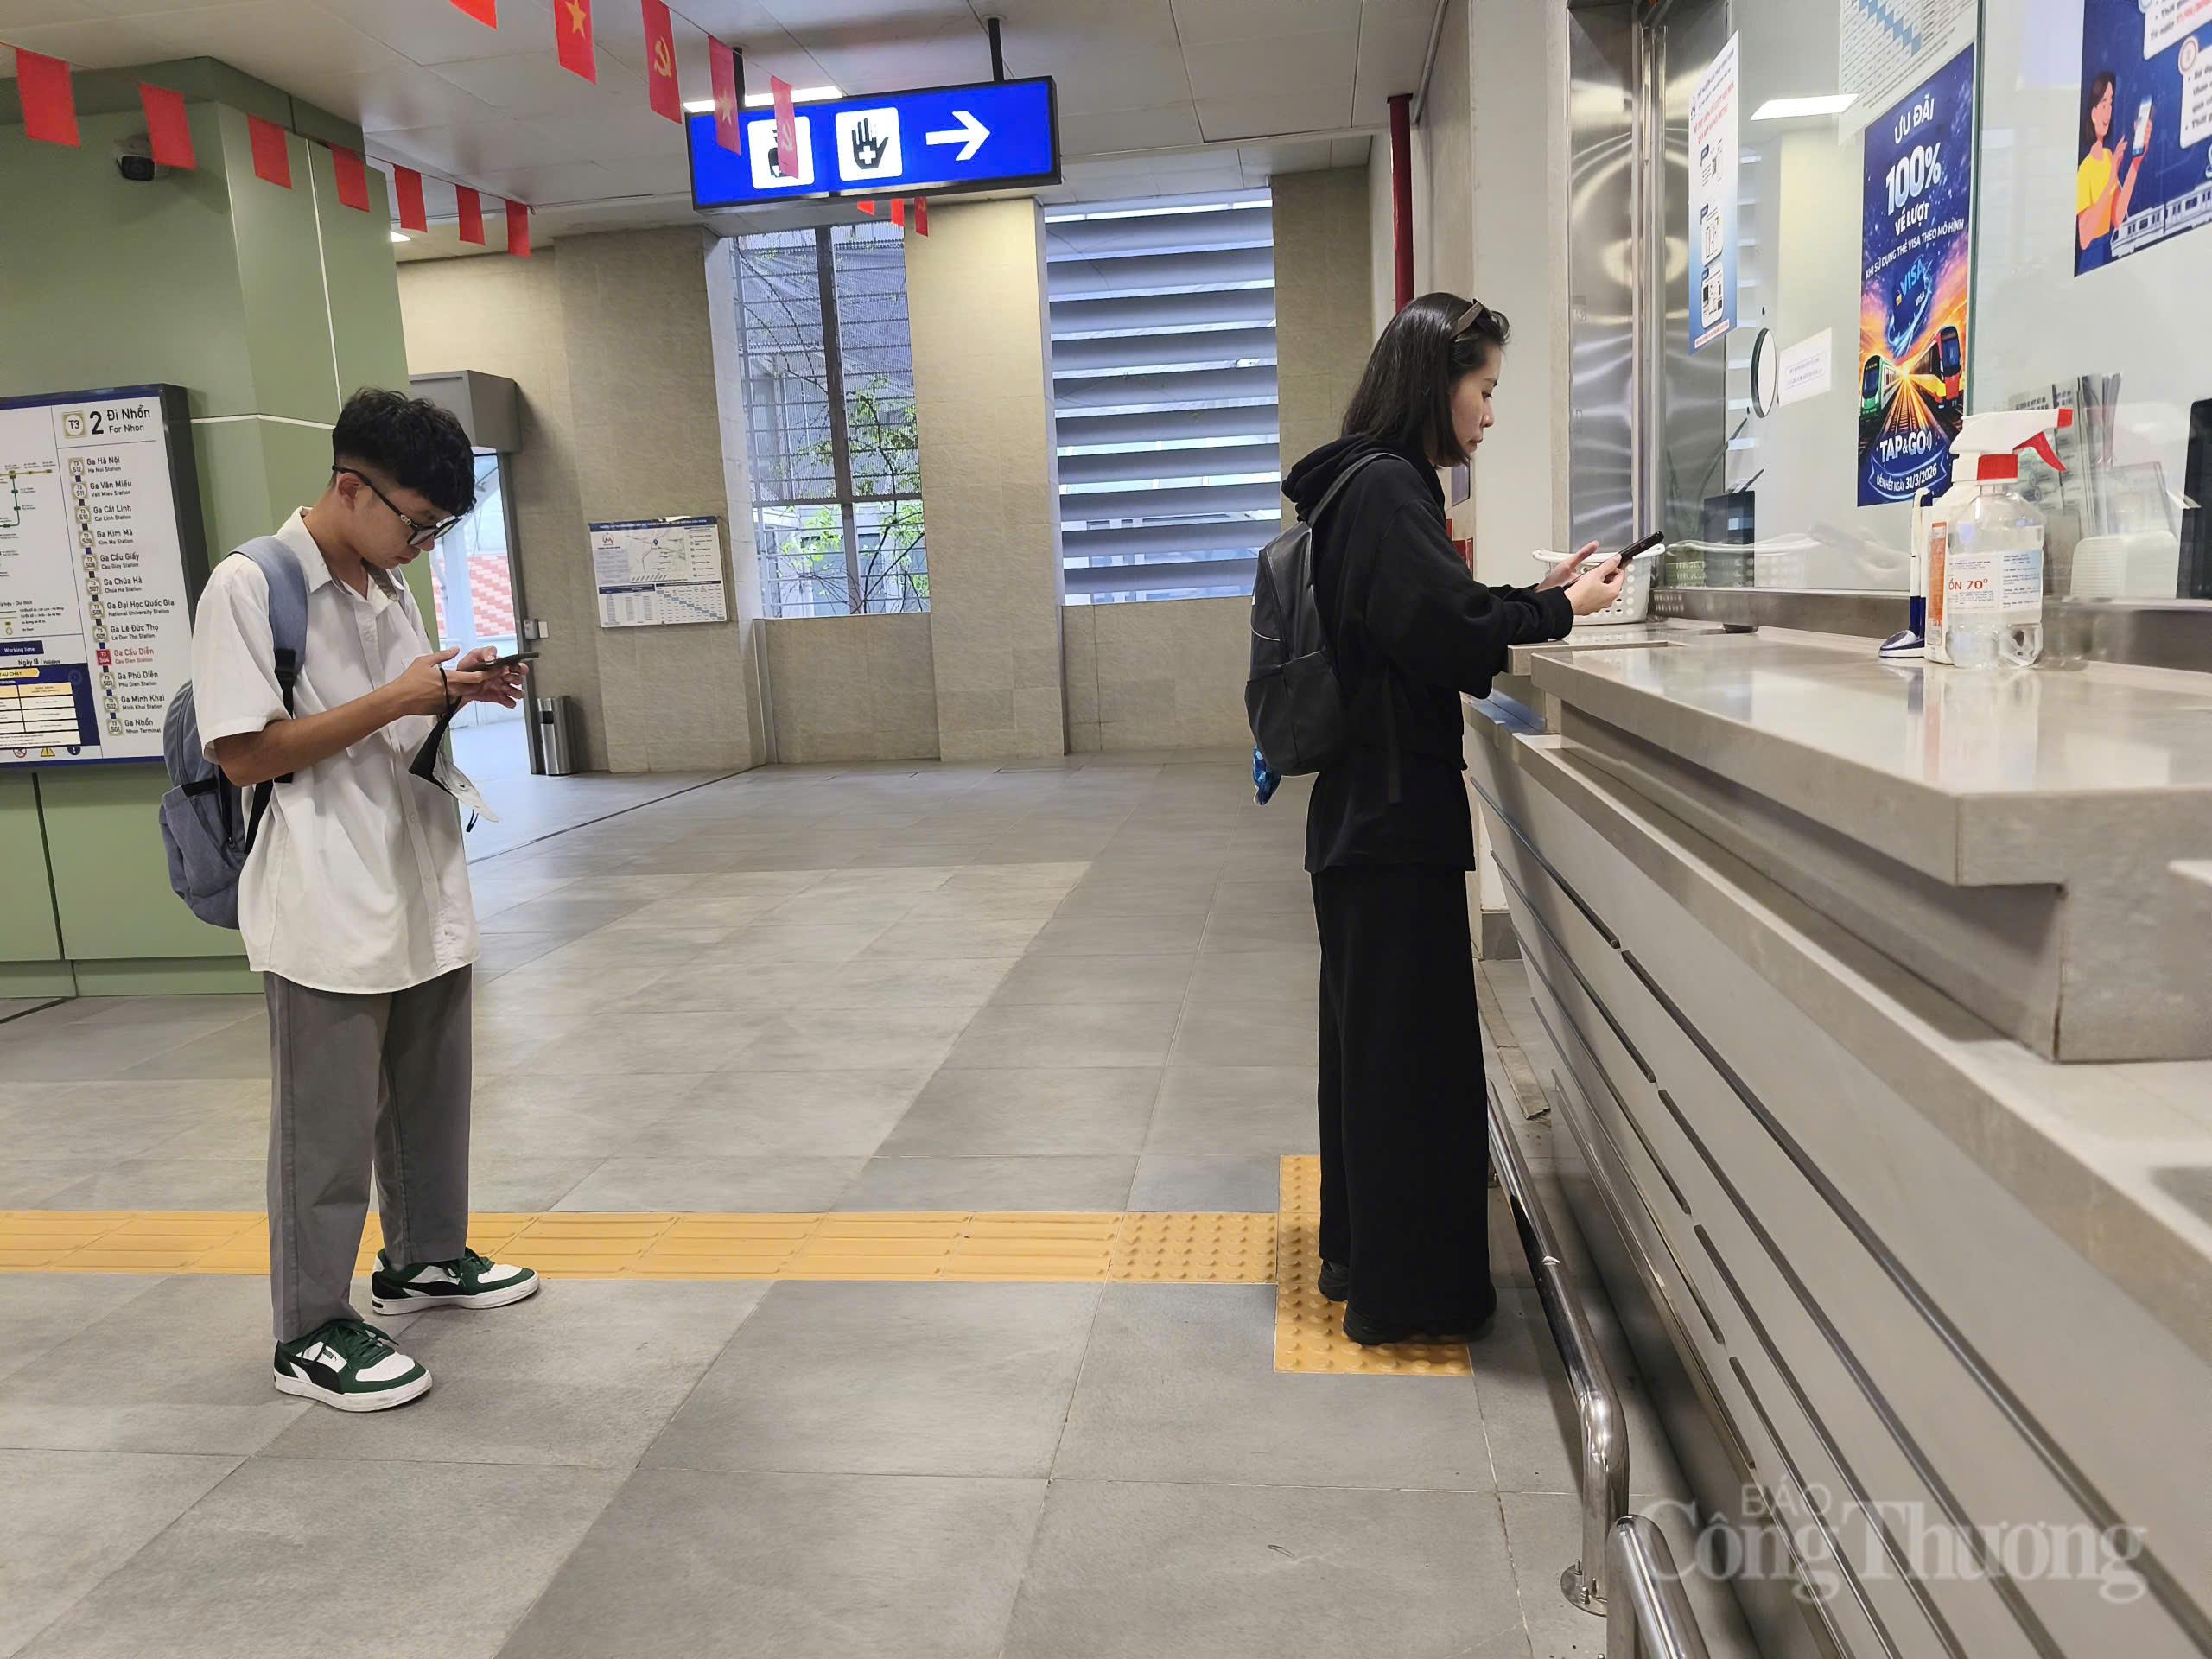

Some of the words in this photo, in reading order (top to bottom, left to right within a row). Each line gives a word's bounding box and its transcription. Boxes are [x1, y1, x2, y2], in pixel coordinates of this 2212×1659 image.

[1895, 111, 1911, 144] ƯU
[1913, 92, 1935, 128] ĐÃI
[1885, 142, 1942, 217] 100%
[1895, 207, 1907, 236] VÉ
[1907, 200, 1929, 227] LƯỢT
[1866, 266, 1874, 280] KHI
[1881, 250, 1897, 267] DỤNG
[1897, 239, 1908, 257] THẺ
[1908, 236, 1921, 251] VISA
[1922, 230, 1936, 244] THEO
[1937, 221, 1948, 238] MÔ
[1948, 217, 1965, 234] HÌNH
[1900, 258, 1925, 296] VISA
[1916, 290, 1925, 306] VISA
[68, 420, 79, 429] T3
[90, 411, 104, 435] 2
[107, 410, 118, 421] Đi
[122, 404, 150, 420] Nhổn
[1880, 431, 1926, 462] TAP&GO
[1894, 478, 1904, 491] NGÀY
[1905, 463, 1937, 489] 31/3/2026
